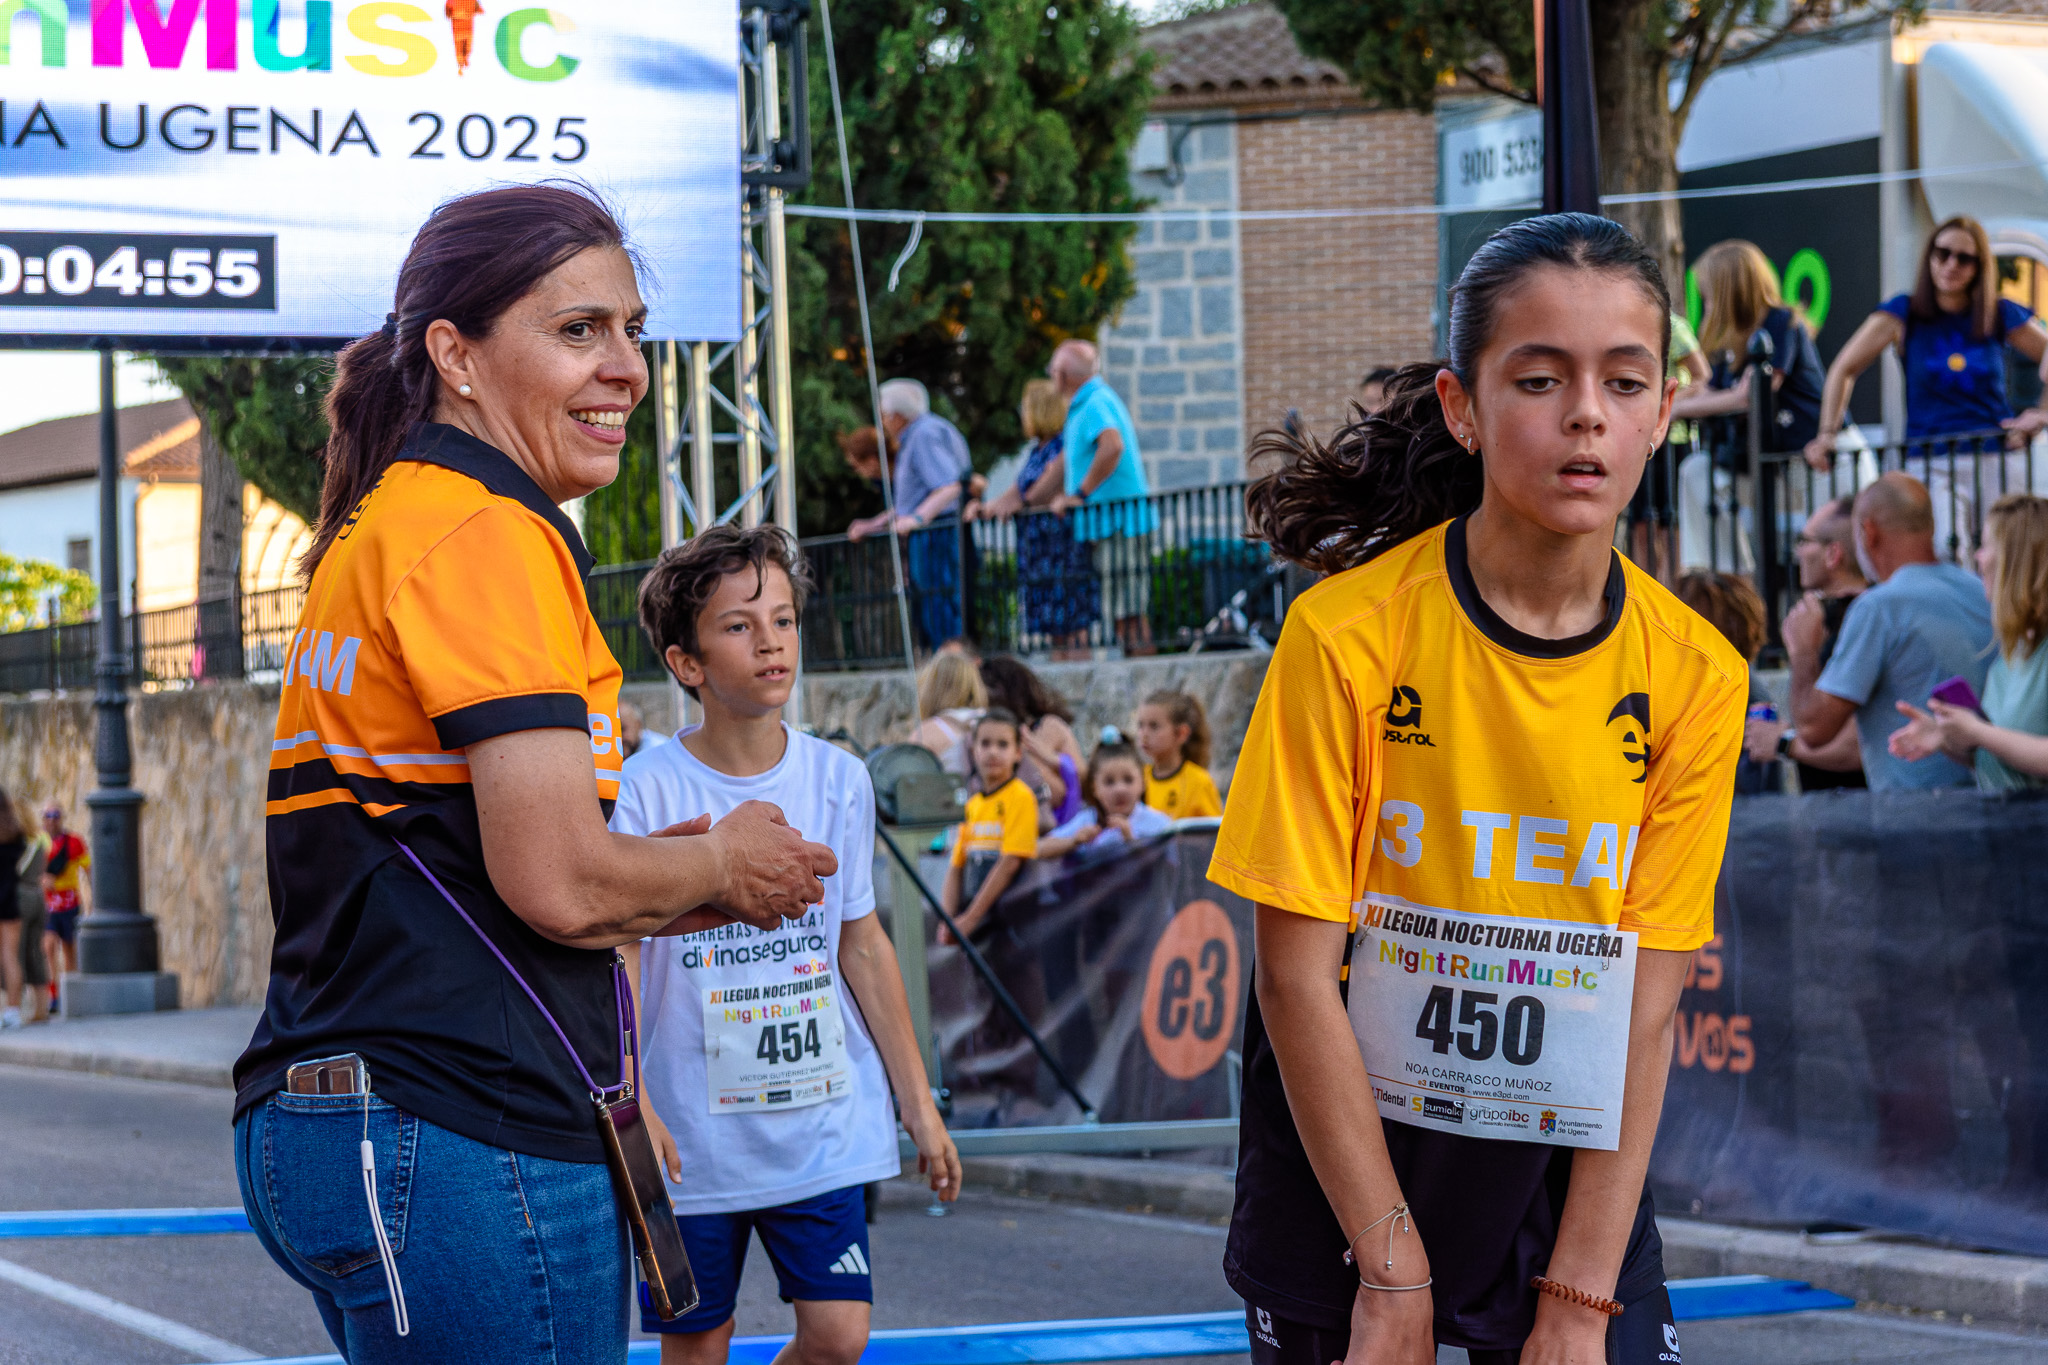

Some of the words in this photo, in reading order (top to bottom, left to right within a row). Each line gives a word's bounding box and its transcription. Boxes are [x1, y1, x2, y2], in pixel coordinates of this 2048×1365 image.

[99, 102, 380, 157] UGENA
[407, 111, 590, 162] 2025
[1459, 149, 1498, 187] 900
[1502, 136, 1544, 178] 533
[1461, 810, 1640, 890] TEA
[1363, 904, 1384, 928] XI
[1382, 908, 1438, 939] LEGUA
[1441, 920, 1552, 953] NOCTURNA
[1556, 932, 1623, 958] UGENA
[710, 991, 722, 1005] XI
[724, 988, 760, 1003] LEGUA
[762, 978, 814, 999] NOCTURNA
[1157, 939, 1229, 1041] e3
[756, 1017, 822, 1065] 454
[1415, 984, 1546, 1067] 450
[1405, 1061, 1430, 1077] NOA
[1432, 1067, 1502, 1087] CARRASCO
[1504, 1077, 1552, 1092] MUÑOZ
[1429, 1081, 1465, 1093] EVENTOS
[1469, 1108, 1530, 1123] grupoibc
[1558, 1119, 1603, 1130] Ayuntamiento
[1567, 1129, 1589, 1137] Ugena
